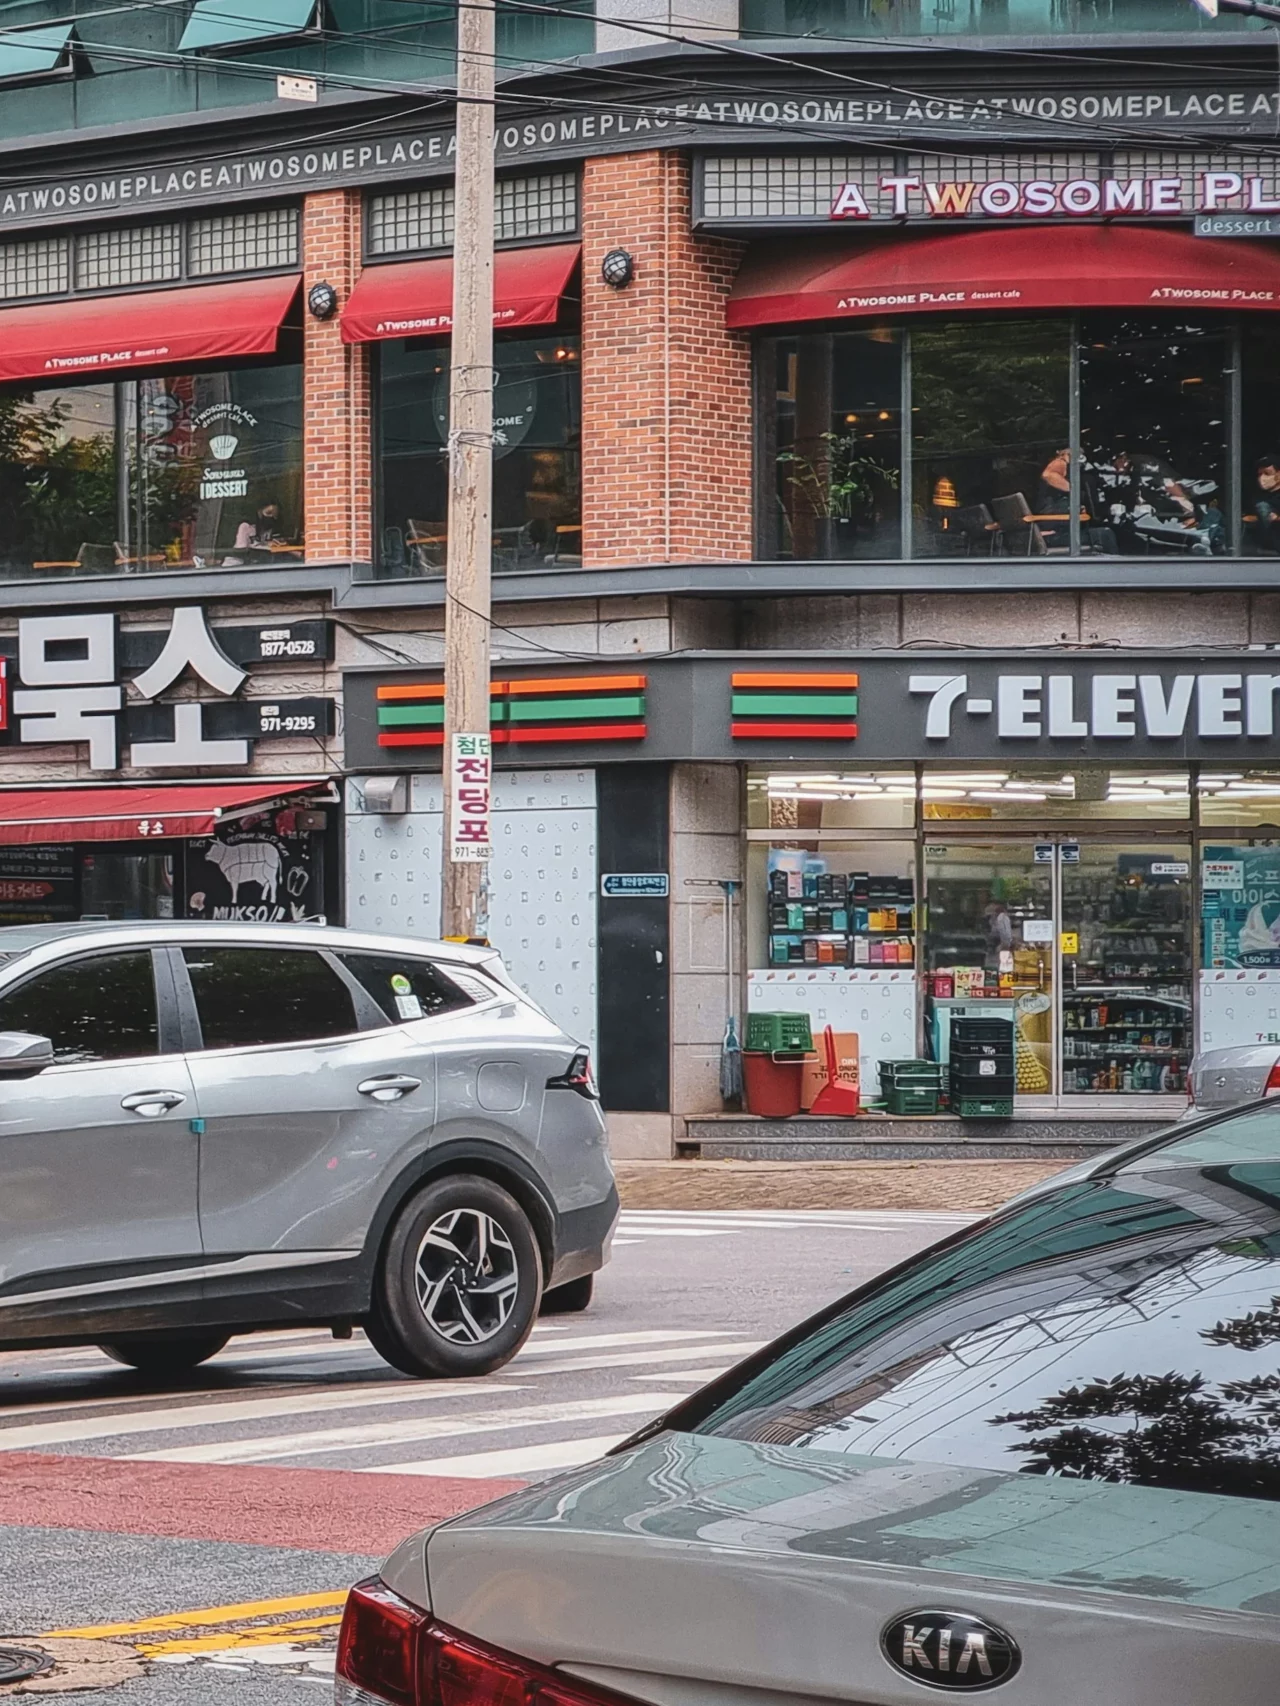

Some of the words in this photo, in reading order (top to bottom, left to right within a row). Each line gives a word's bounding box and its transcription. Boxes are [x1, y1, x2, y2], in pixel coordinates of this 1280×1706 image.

[880, 175, 1182, 218] TWOSOME
[1200, 217, 1272, 234] dessert
[920, 292, 965, 303] PLACE
[971, 291, 1001, 300] dessert
[1003, 290, 1020, 298] cafe
[1231, 289, 1274, 300] PLACE
[100, 350, 132, 363] PLACE
[260, 641, 316, 656] 1877-0528
[13, 605, 251, 770] 묵소
[260, 716, 316, 731] 971-9295
[455, 757, 490, 843] 전당포
[137, 820, 164, 837] 묵소
[212, 905, 268, 921] MUKSO
[902, 1624, 993, 1676] KIA
